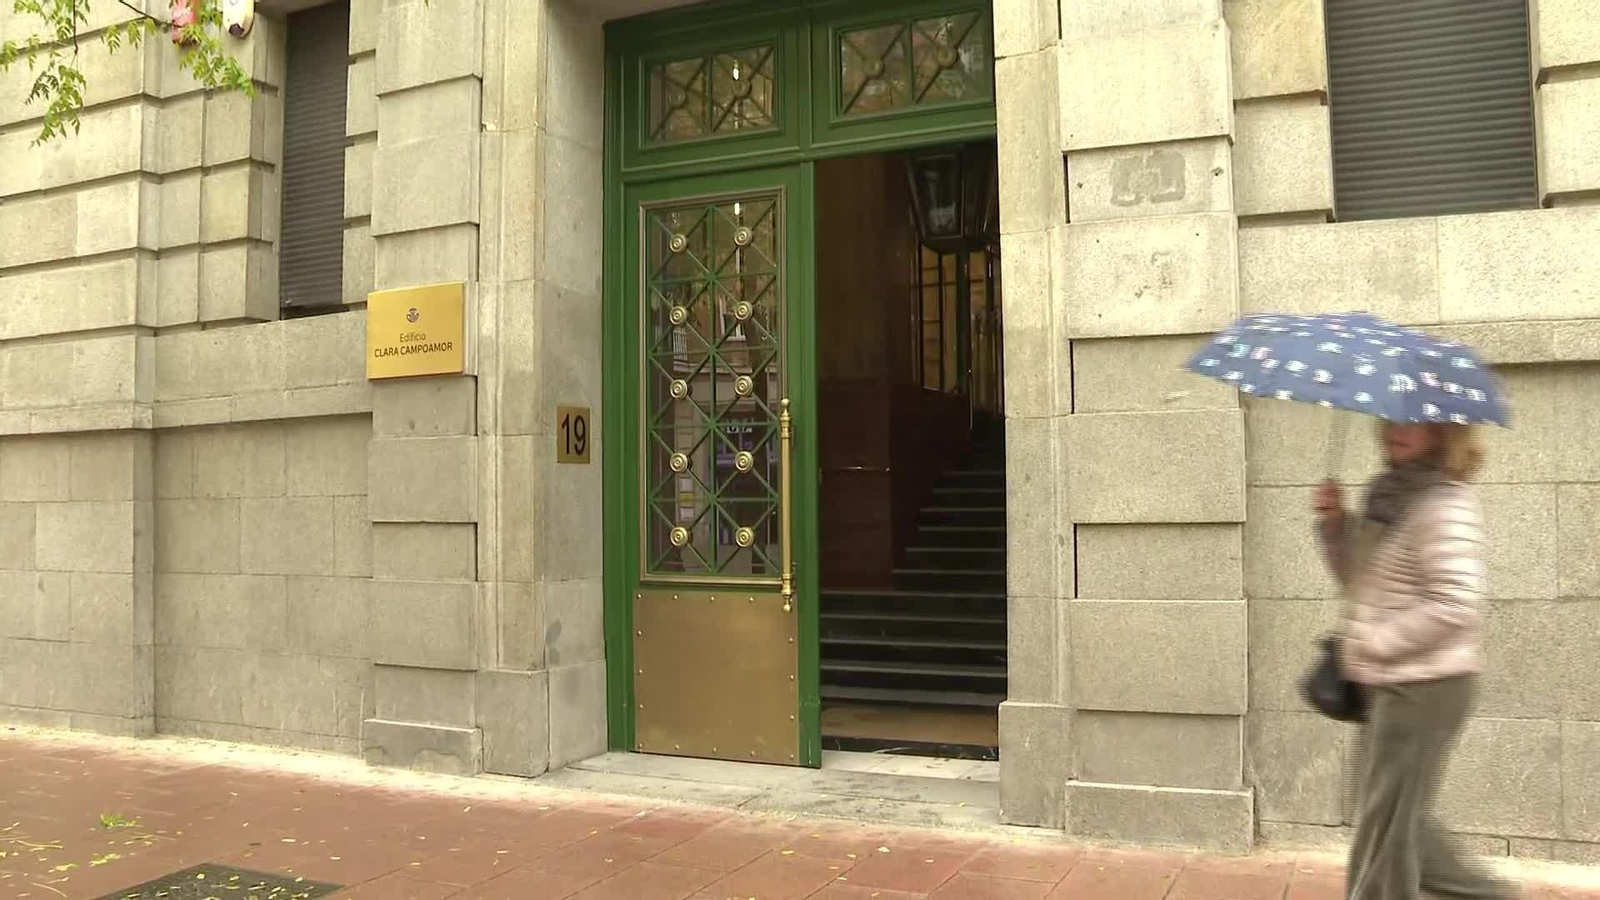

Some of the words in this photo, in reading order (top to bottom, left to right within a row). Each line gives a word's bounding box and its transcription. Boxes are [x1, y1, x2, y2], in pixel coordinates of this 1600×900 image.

[399, 333, 426, 342] Edificio
[374, 347, 399, 358] CLARA
[400, 342, 453, 355] CAMPOAMOR
[561, 413, 586, 456] 19
